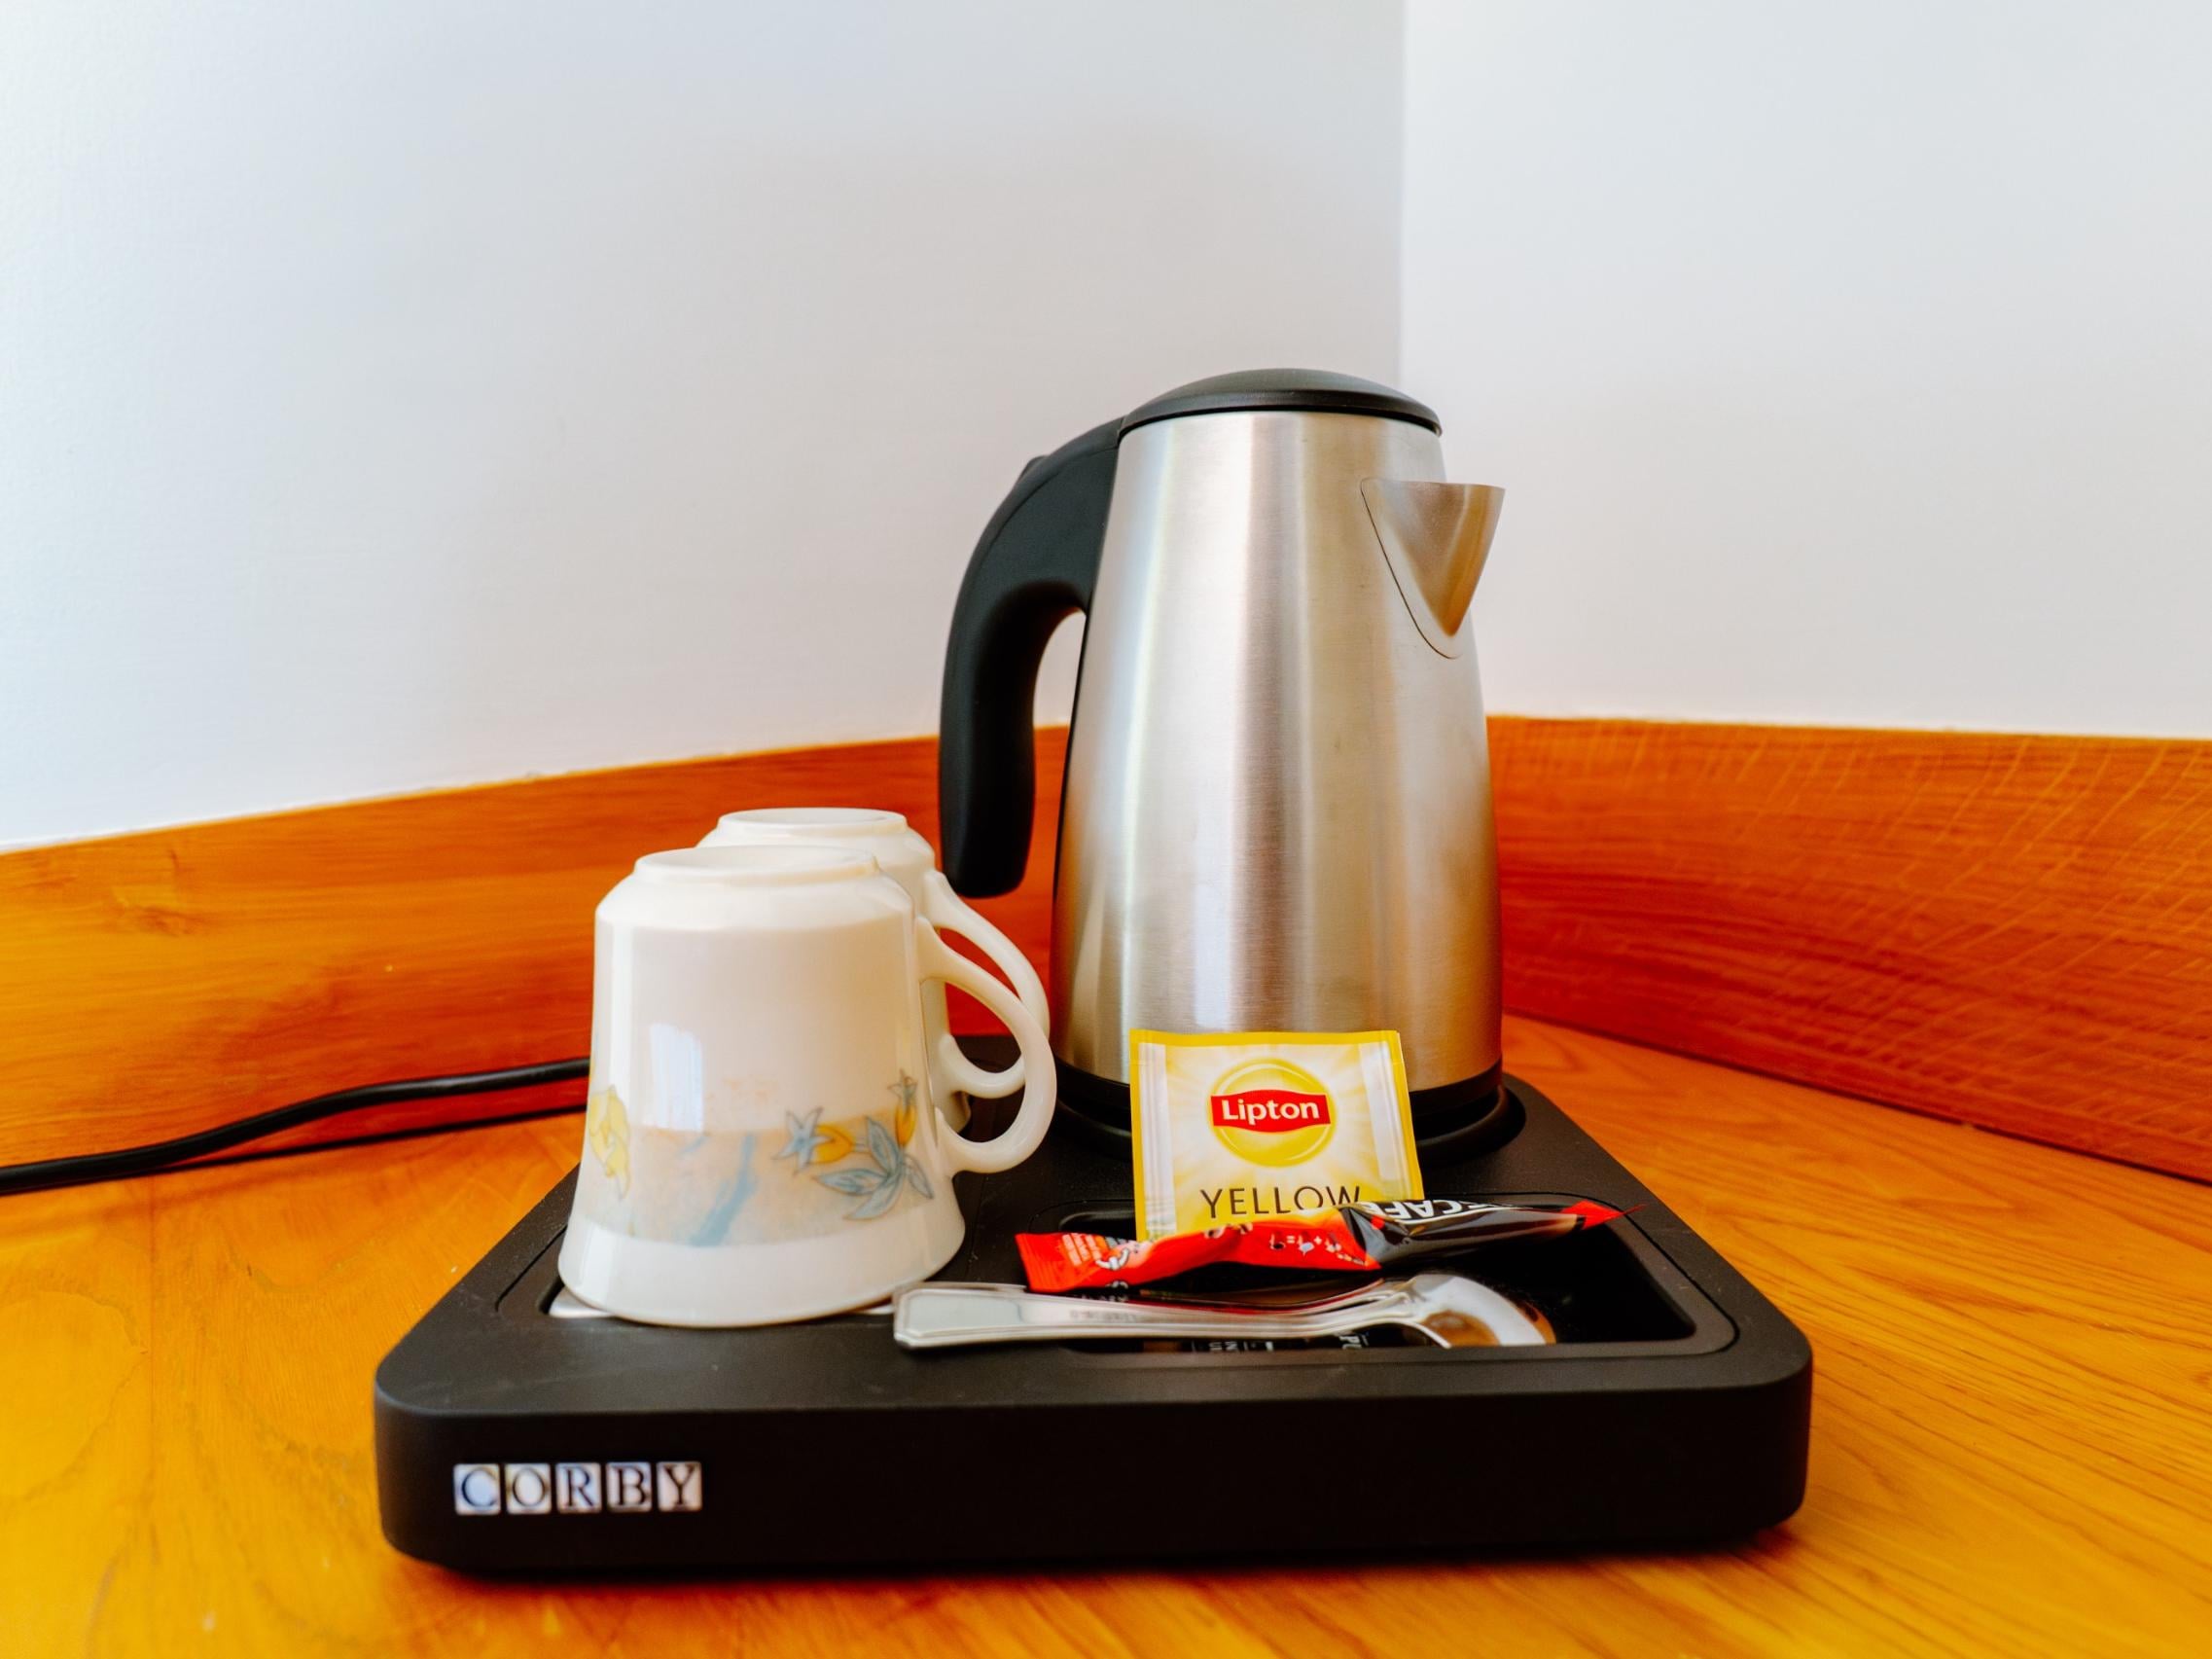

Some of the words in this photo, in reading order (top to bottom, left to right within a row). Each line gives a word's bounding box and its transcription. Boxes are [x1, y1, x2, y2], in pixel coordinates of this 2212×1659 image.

[1221, 1099, 1320, 1126] Lipton
[1199, 1185, 1361, 1218] YELLOW
[460, 1463, 698, 1508] CORBY
